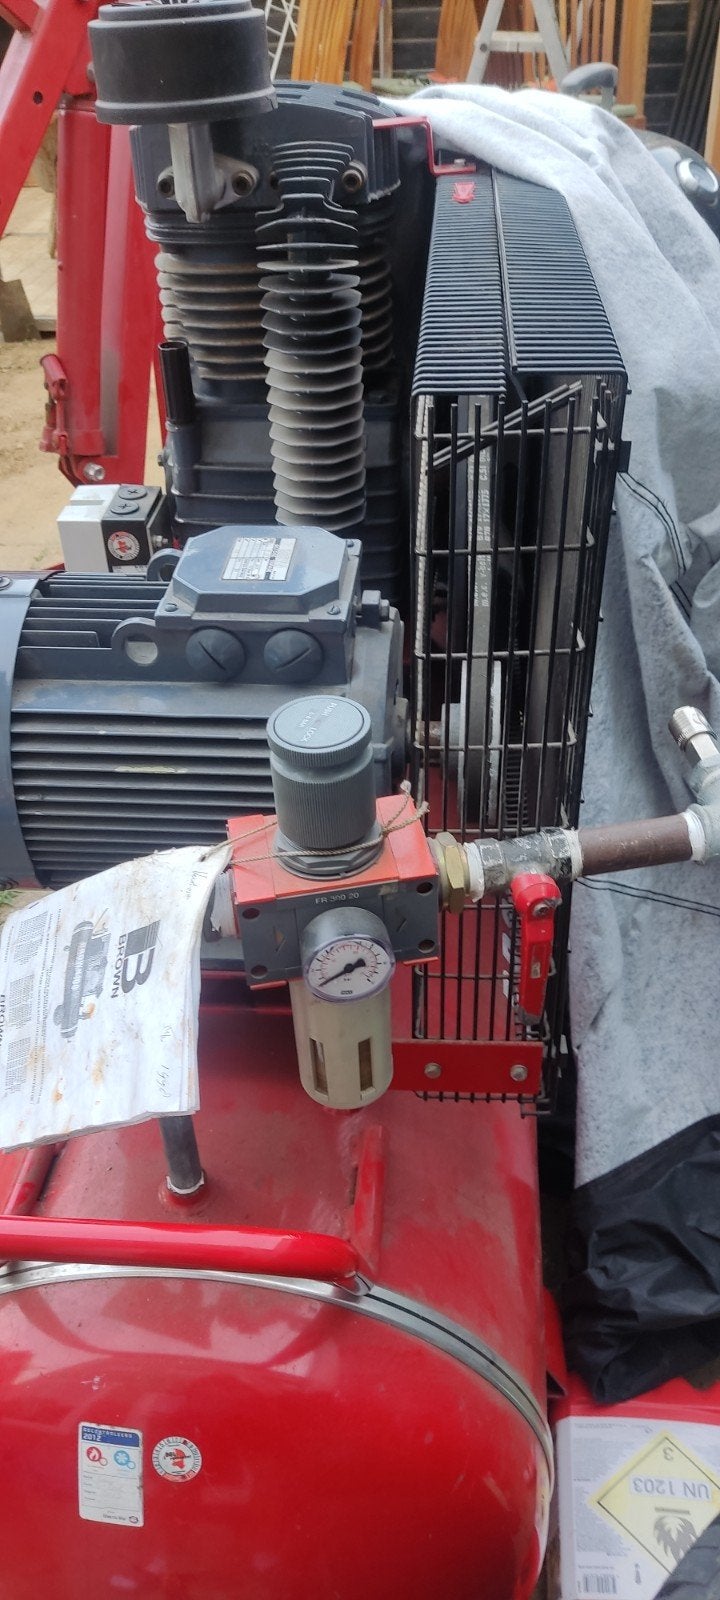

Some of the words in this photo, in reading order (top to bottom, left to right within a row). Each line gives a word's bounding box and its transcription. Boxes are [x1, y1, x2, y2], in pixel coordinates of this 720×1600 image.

[110, 934, 127, 999] BROWN
[83, 1433, 102, 1442] 2012
[662, 1447, 674, 1461] 3
[633, 1477, 675, 1492] 1203
[683, 1481, 710, 1499] UN
